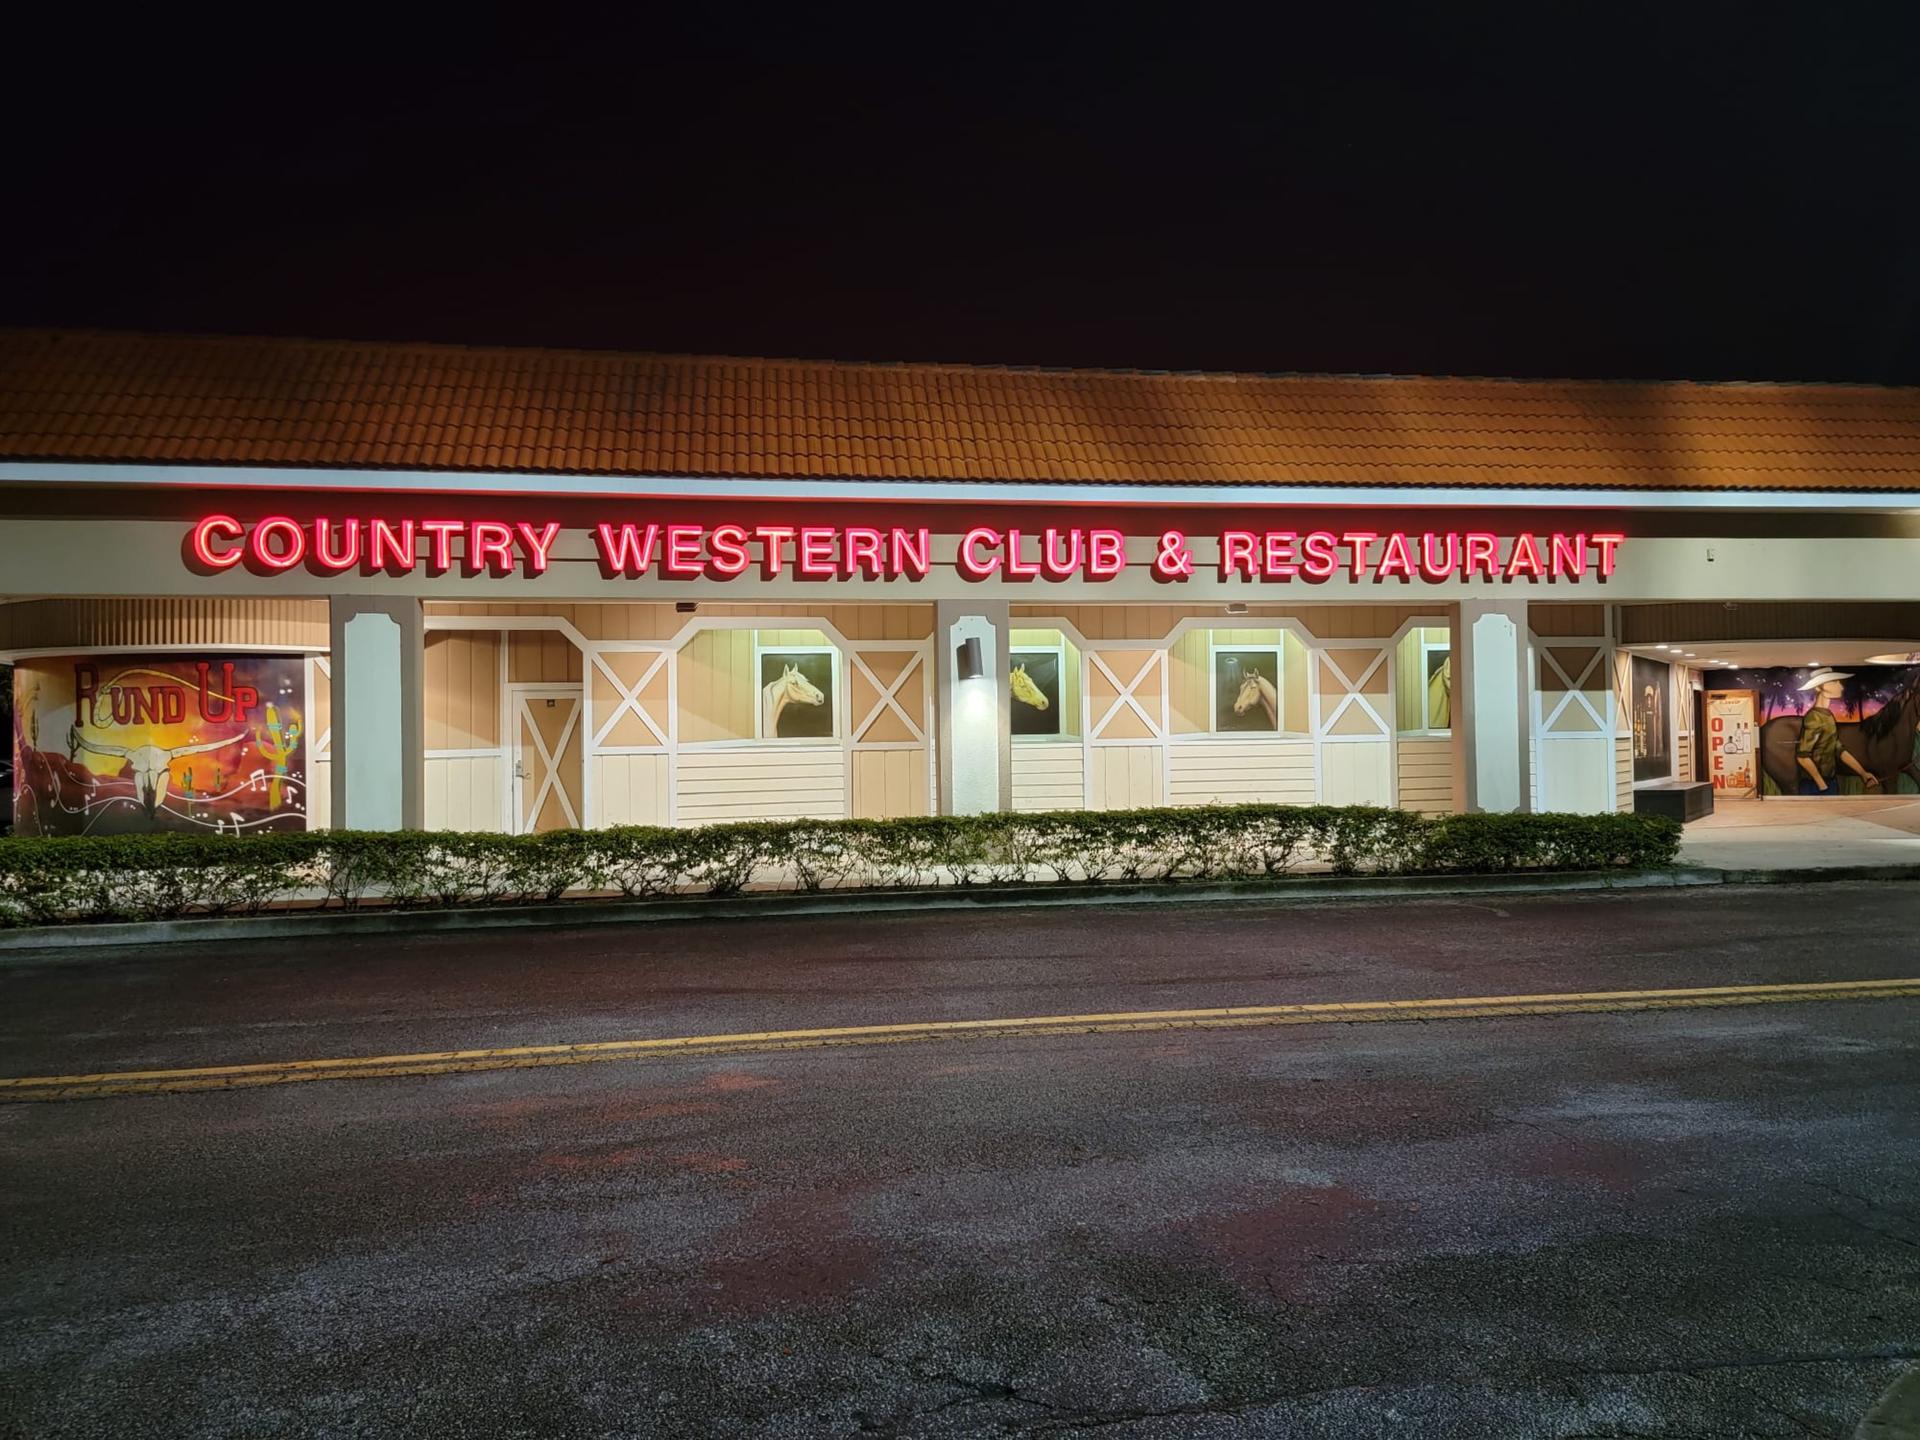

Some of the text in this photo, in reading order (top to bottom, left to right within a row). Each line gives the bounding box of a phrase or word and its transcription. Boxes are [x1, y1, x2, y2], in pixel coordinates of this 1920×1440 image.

[193, 513, 1625, 578] COUNTRY WESTERN CLUB & RESTAURANT
[75, 662, 258, 728] ROUND UP
[1711, 717, 1725, 789] OPEN
